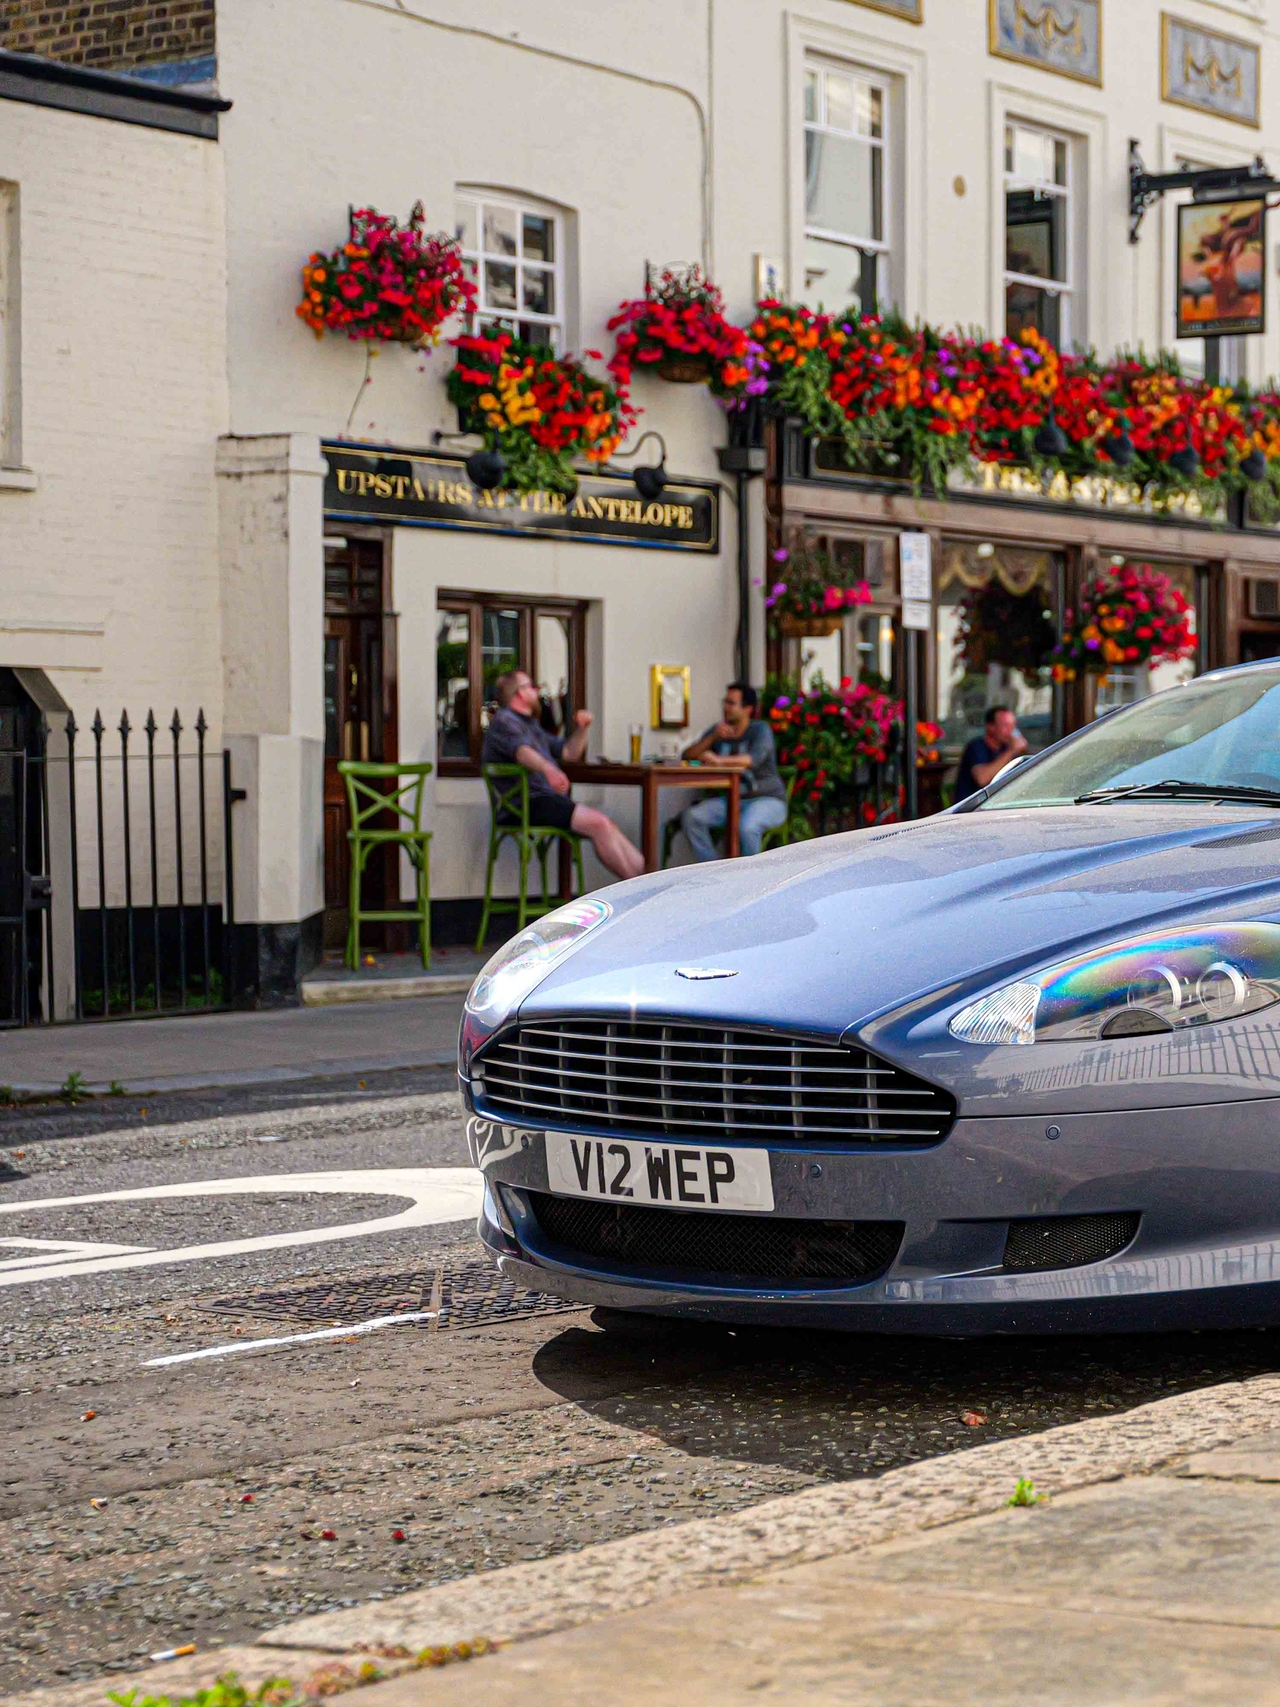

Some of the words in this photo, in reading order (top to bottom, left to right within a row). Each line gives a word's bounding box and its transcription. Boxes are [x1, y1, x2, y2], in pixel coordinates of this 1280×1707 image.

[336, 469, 474, 506] UPSTAIRS
[477, 487, 510, 509] AT
[571, 496, 693, 530] ANTELOPE
[570, 1139, 634, 1197] V12
[644, 1147, 736, 1204] WEP
